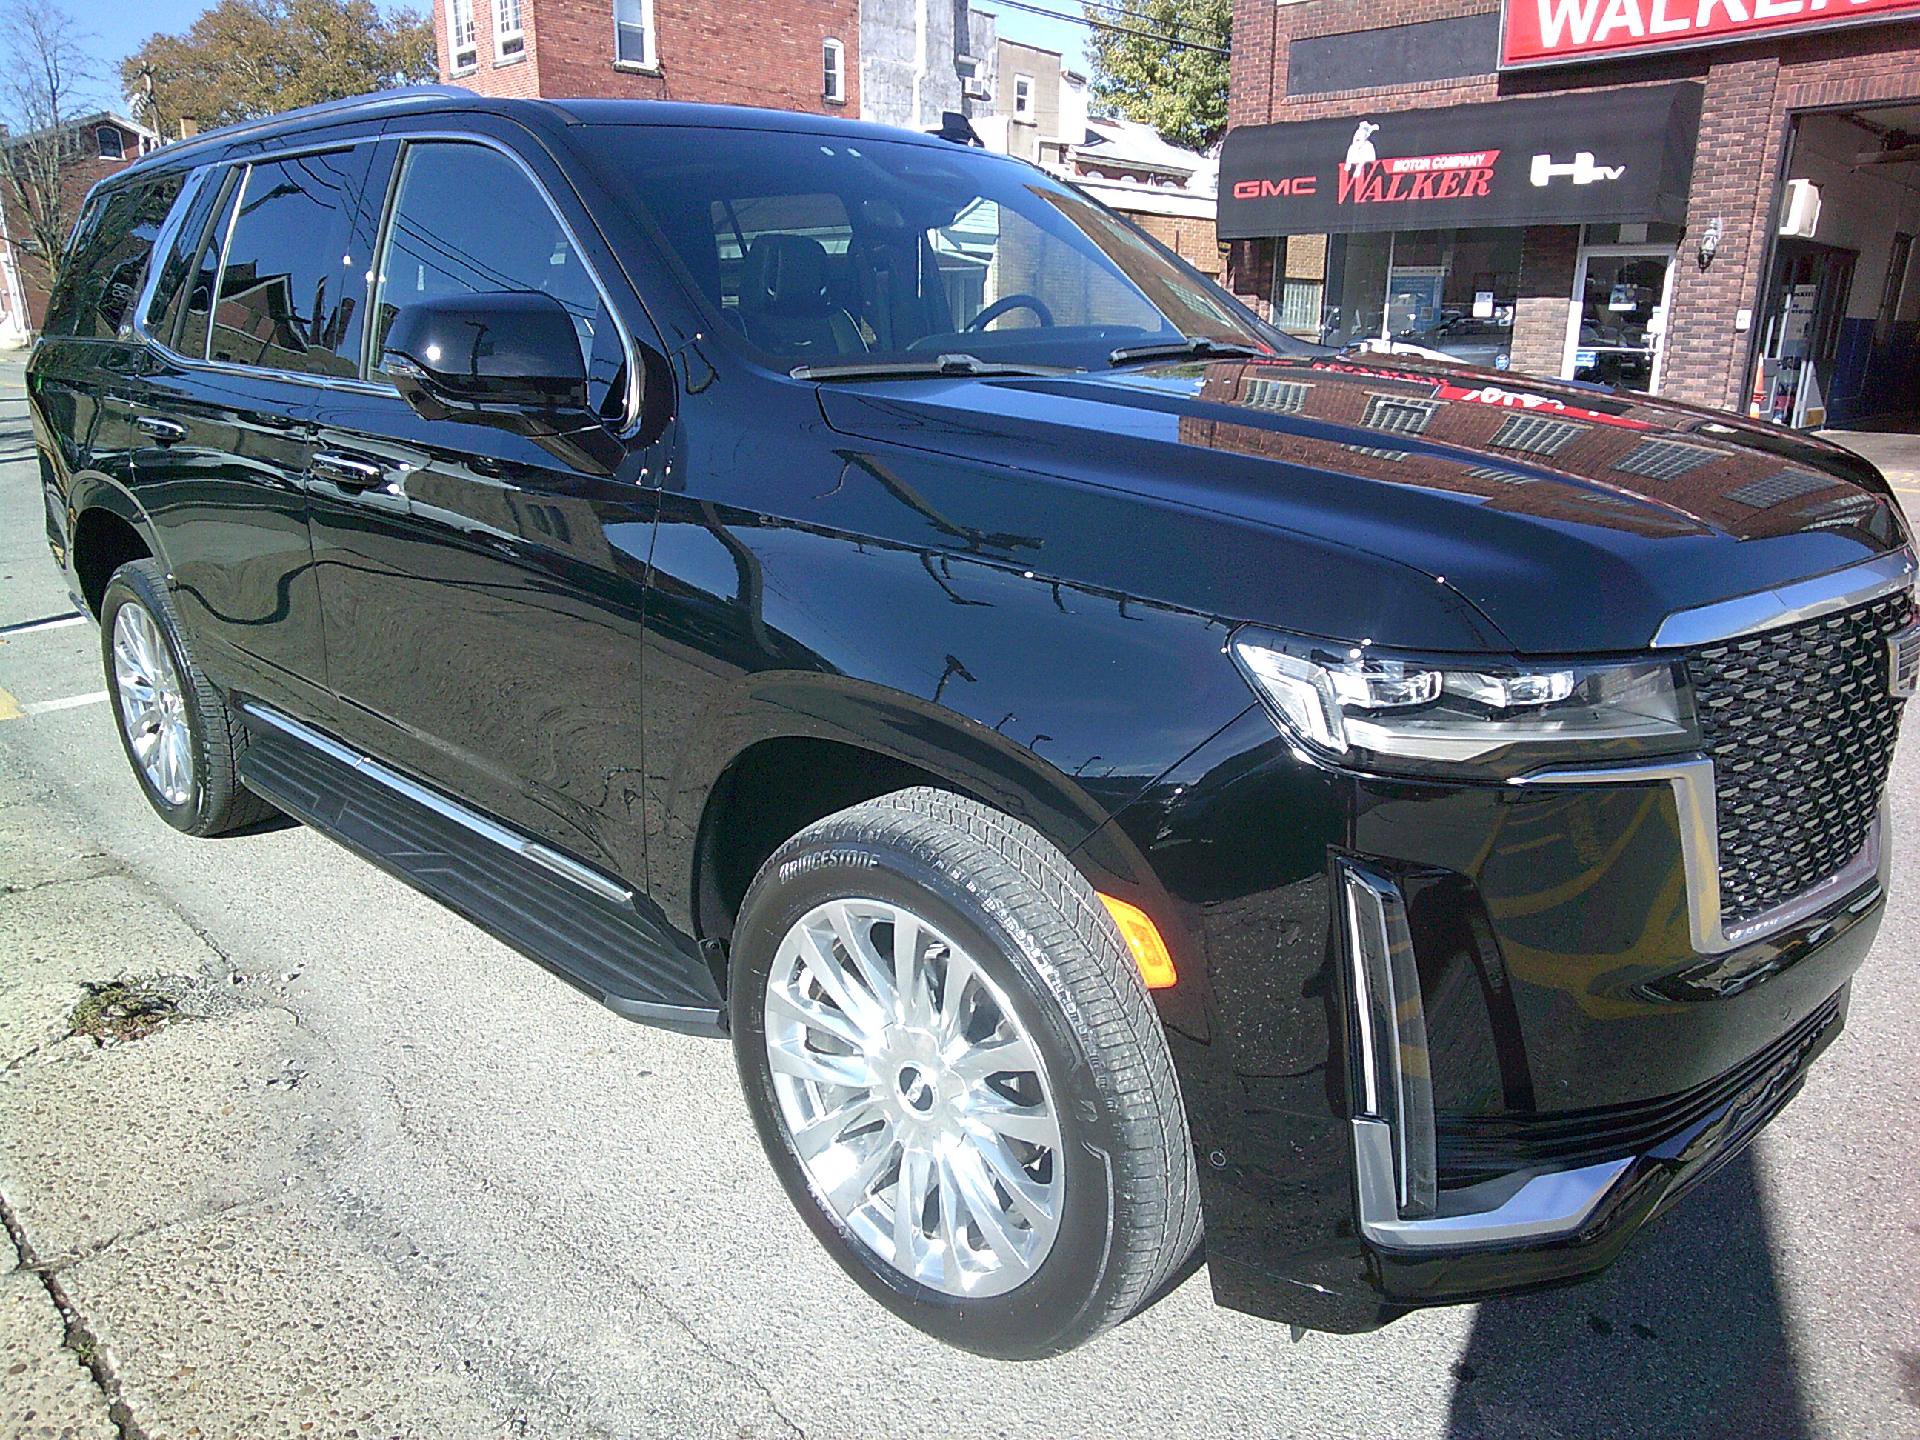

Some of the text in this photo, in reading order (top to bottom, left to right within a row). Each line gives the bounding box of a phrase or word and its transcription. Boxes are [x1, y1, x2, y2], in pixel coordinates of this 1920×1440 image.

[1537, 0, 1870, 48] WALK
[1393, 154, 1486, 172] MOTOR COMPANY
[1233, 176, 1317, 199] GMC
[1338, 161, 1494, 204] WALKER
[779, 849, 881, 885] BRIDGESTONE
